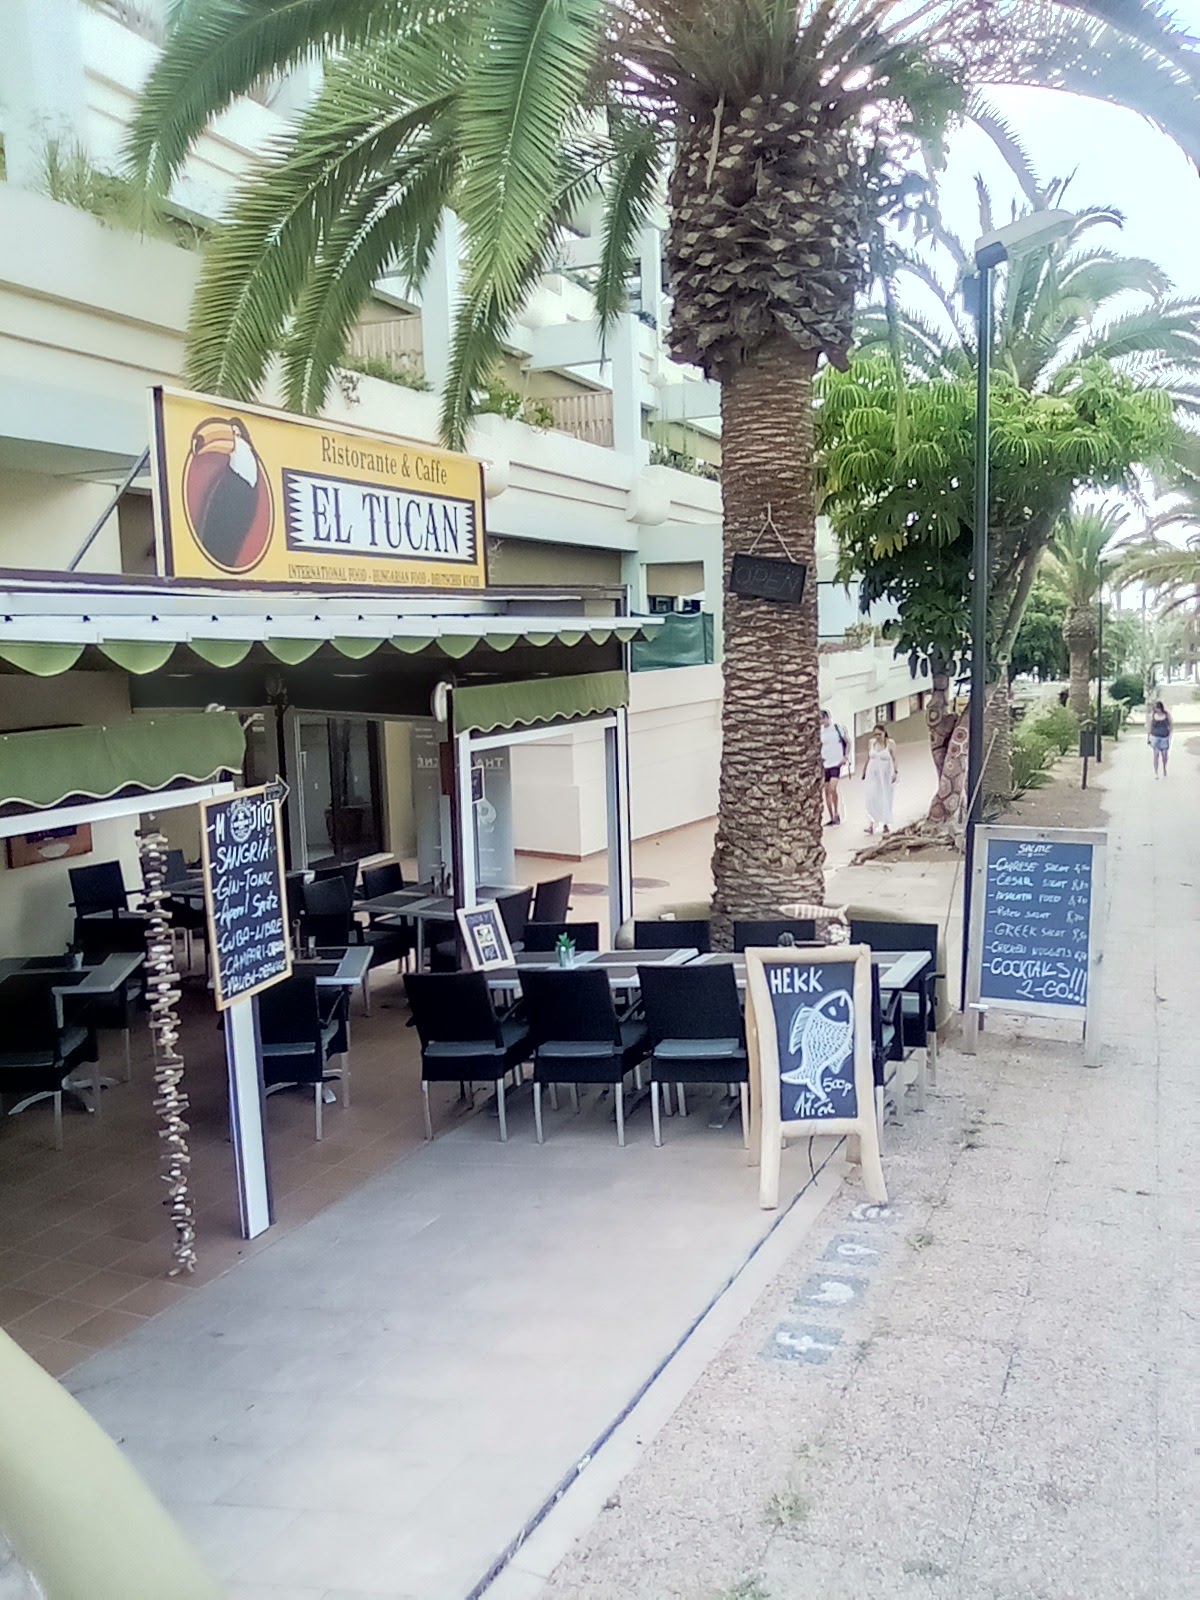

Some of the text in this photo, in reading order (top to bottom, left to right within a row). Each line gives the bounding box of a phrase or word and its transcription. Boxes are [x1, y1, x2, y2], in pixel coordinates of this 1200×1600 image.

[321, 435, 448, 485] Ristorante & Caffe
[310, 483, 461, 554] EL TUCAN
[288, 563, 347, 581] INTERNATIONAL
[349, 567, 367, 582] FOOD
[410, 571, 427, 585] FOOD
[735, 566, 800, 594] OPEN
[994, 922, 1037, 938] GREEK
[770, 966, 824, 995] HEKK
